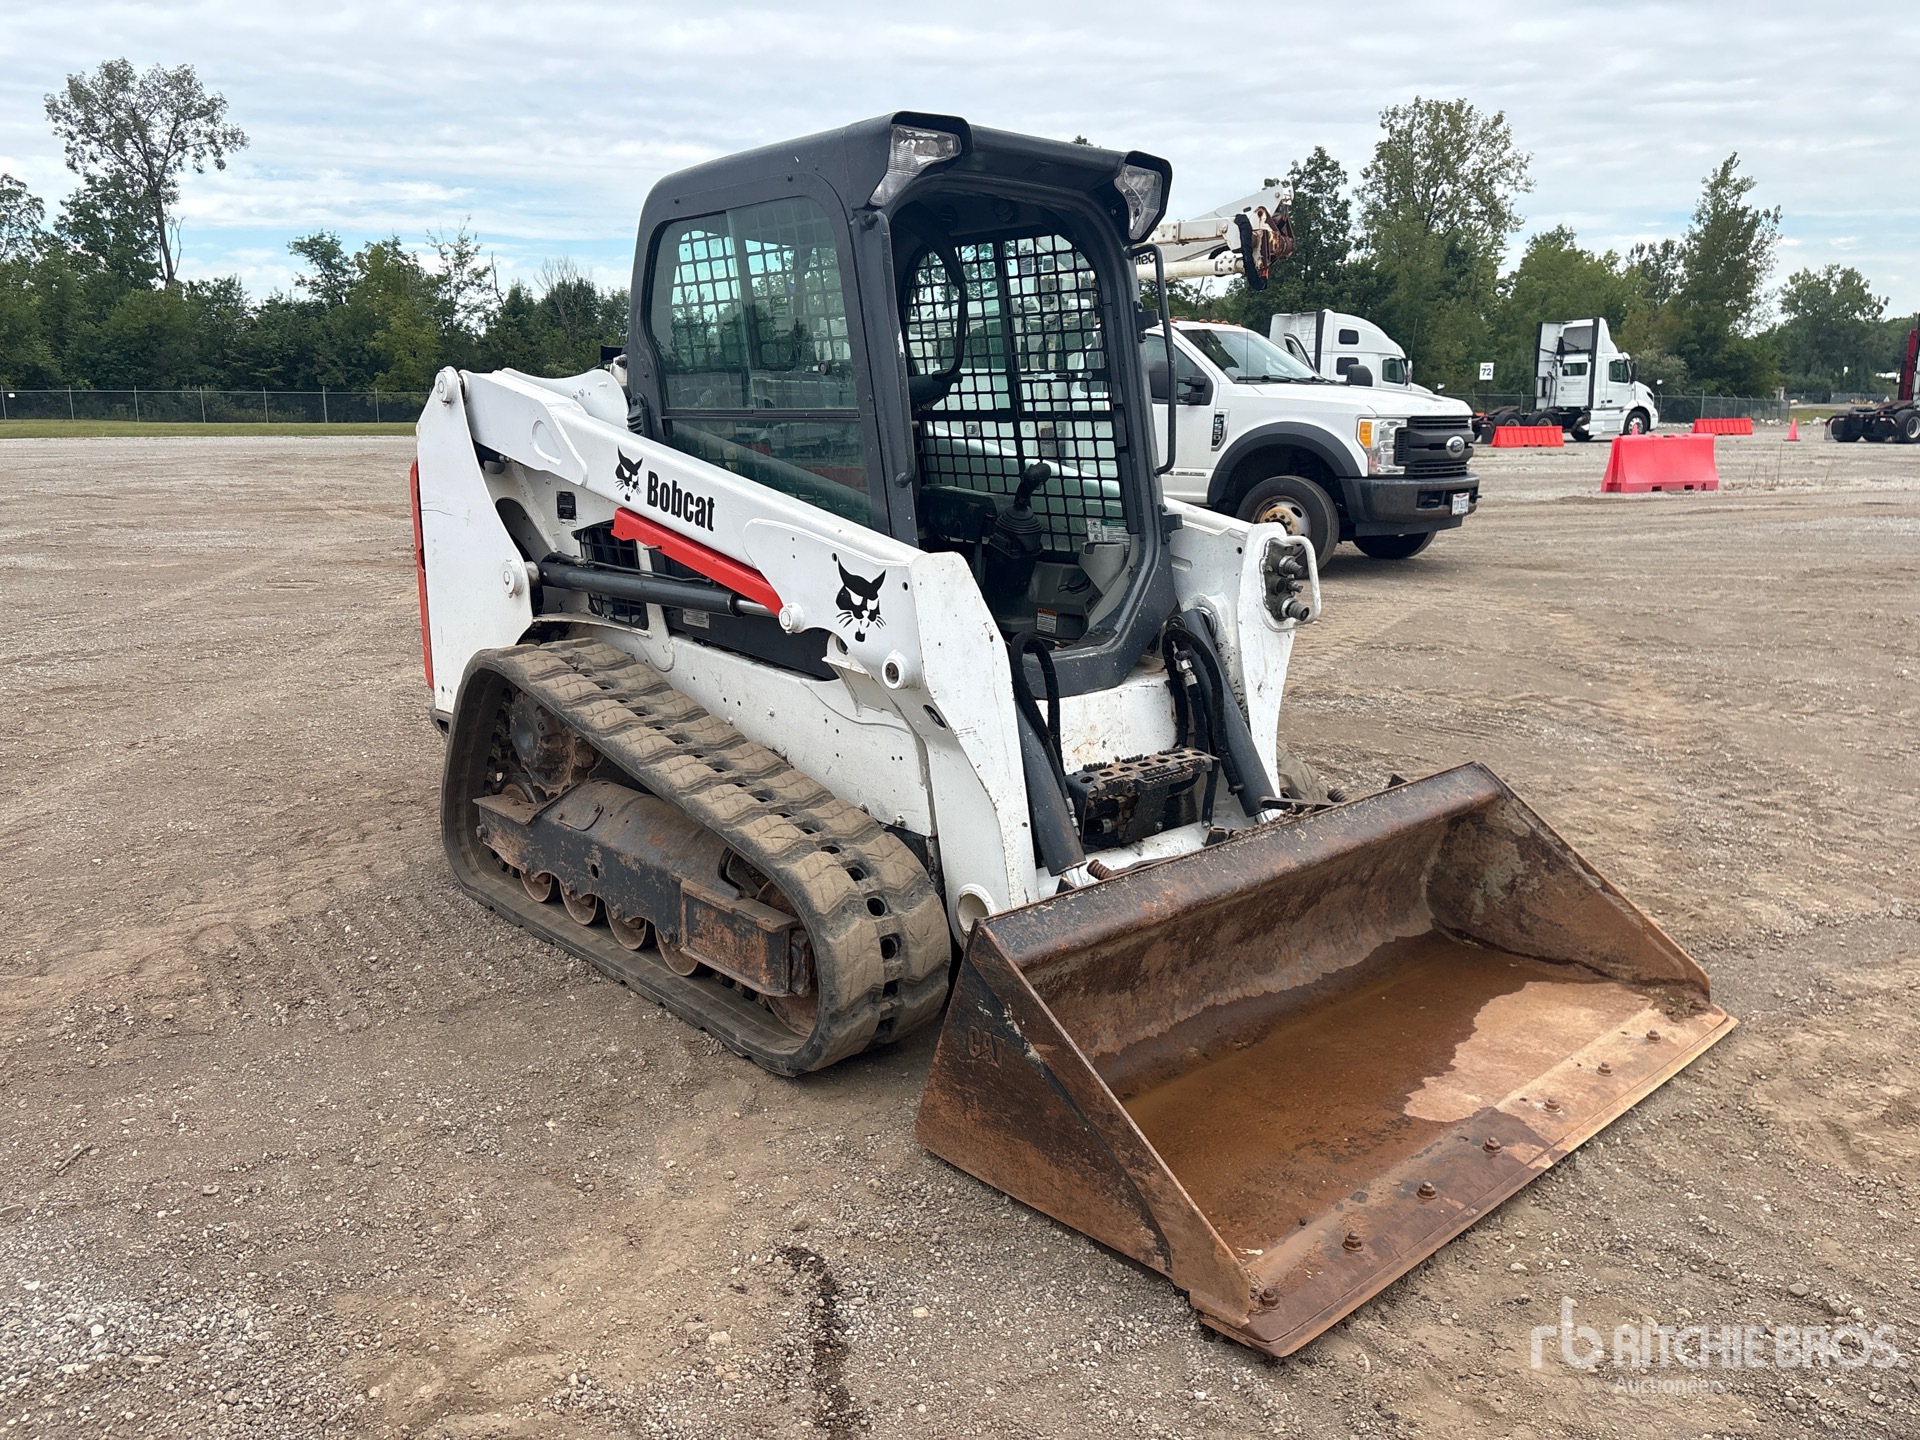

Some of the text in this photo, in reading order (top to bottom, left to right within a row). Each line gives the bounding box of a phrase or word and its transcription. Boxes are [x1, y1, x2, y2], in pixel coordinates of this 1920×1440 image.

[1481, 367, 1491, 376] 72
[647, 470, 715, 532] Bobcat
[968, 1025, 1006, 1068] CAT
